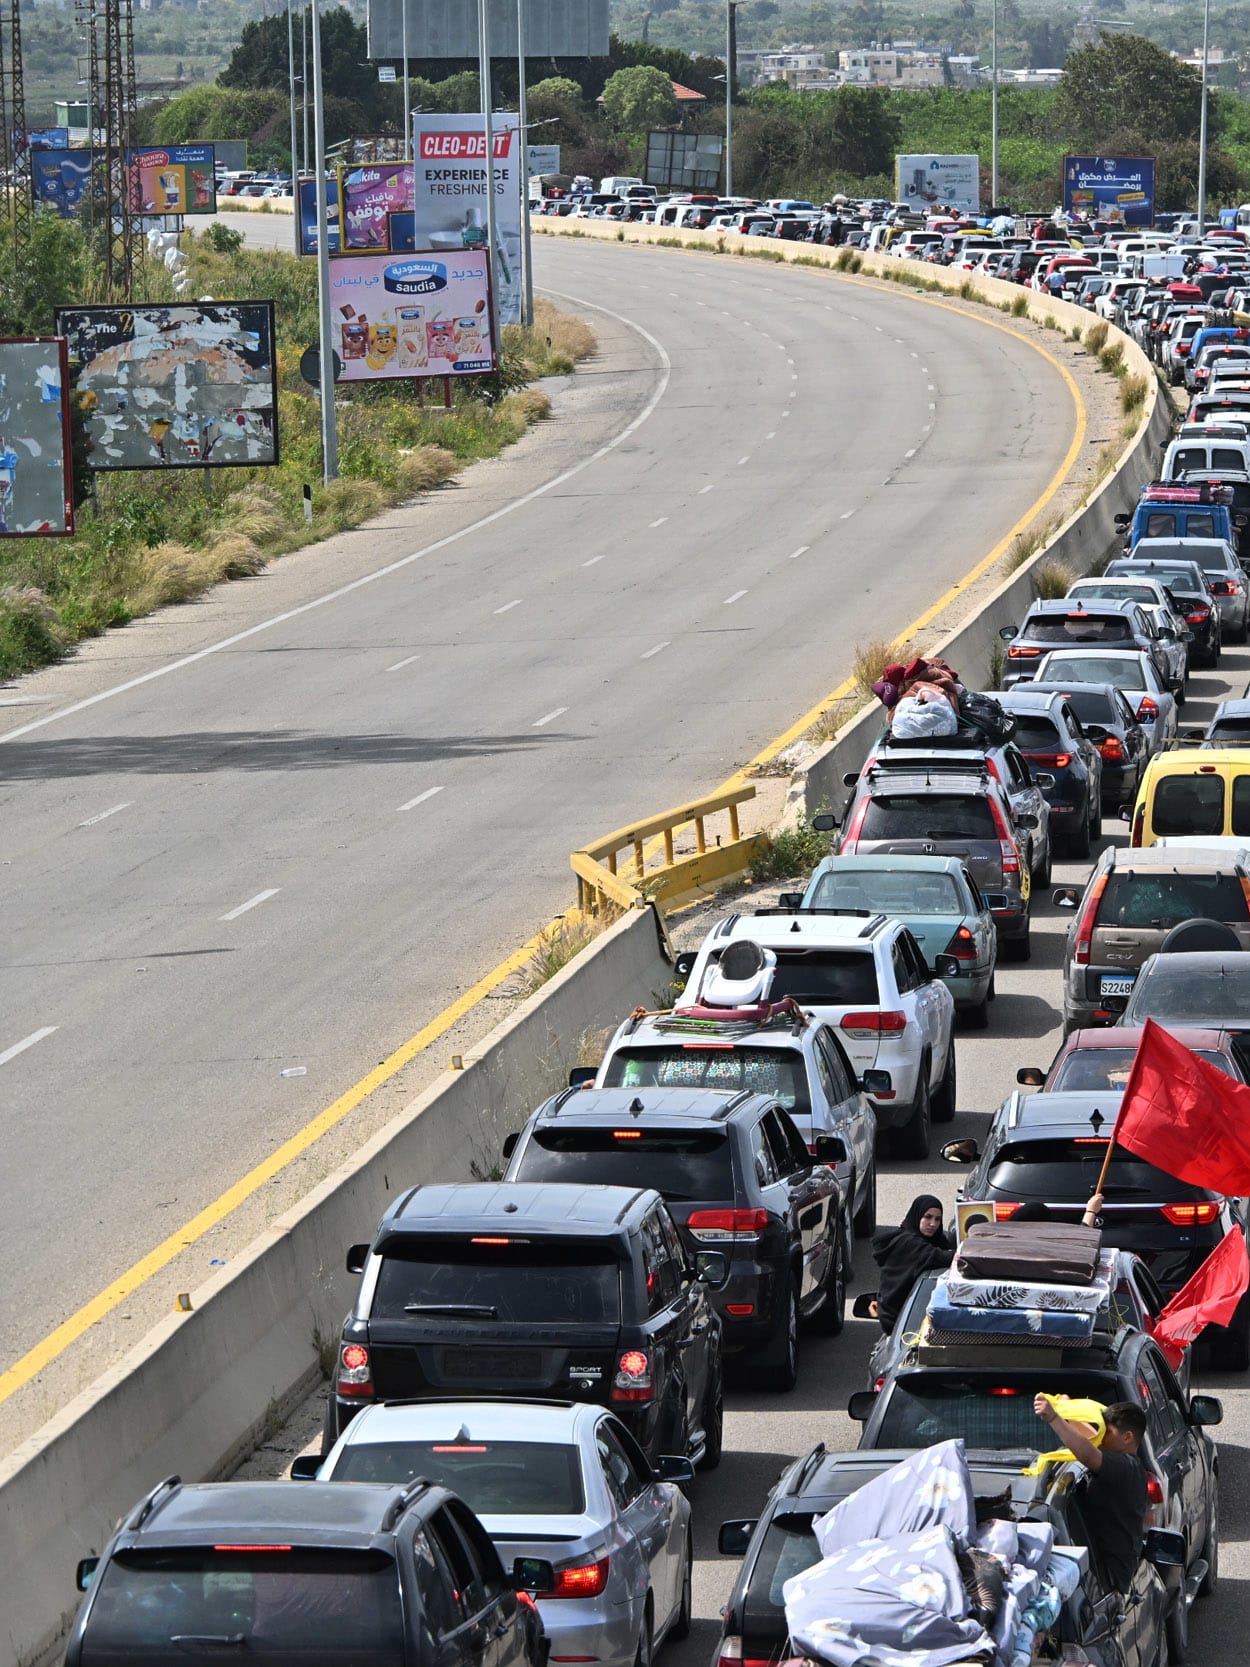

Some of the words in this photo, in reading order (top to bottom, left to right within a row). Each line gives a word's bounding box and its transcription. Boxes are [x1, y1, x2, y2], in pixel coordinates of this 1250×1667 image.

[424, 136, 506, 155] CLEO-DET
[425, 169, 509, 180] EXPERIENCE
[452, 268, 484, 281] جديد
[365, 274, 380, 288] في
[396, 281, 436, 292] saudia
[94, 324, 117, 334] The
